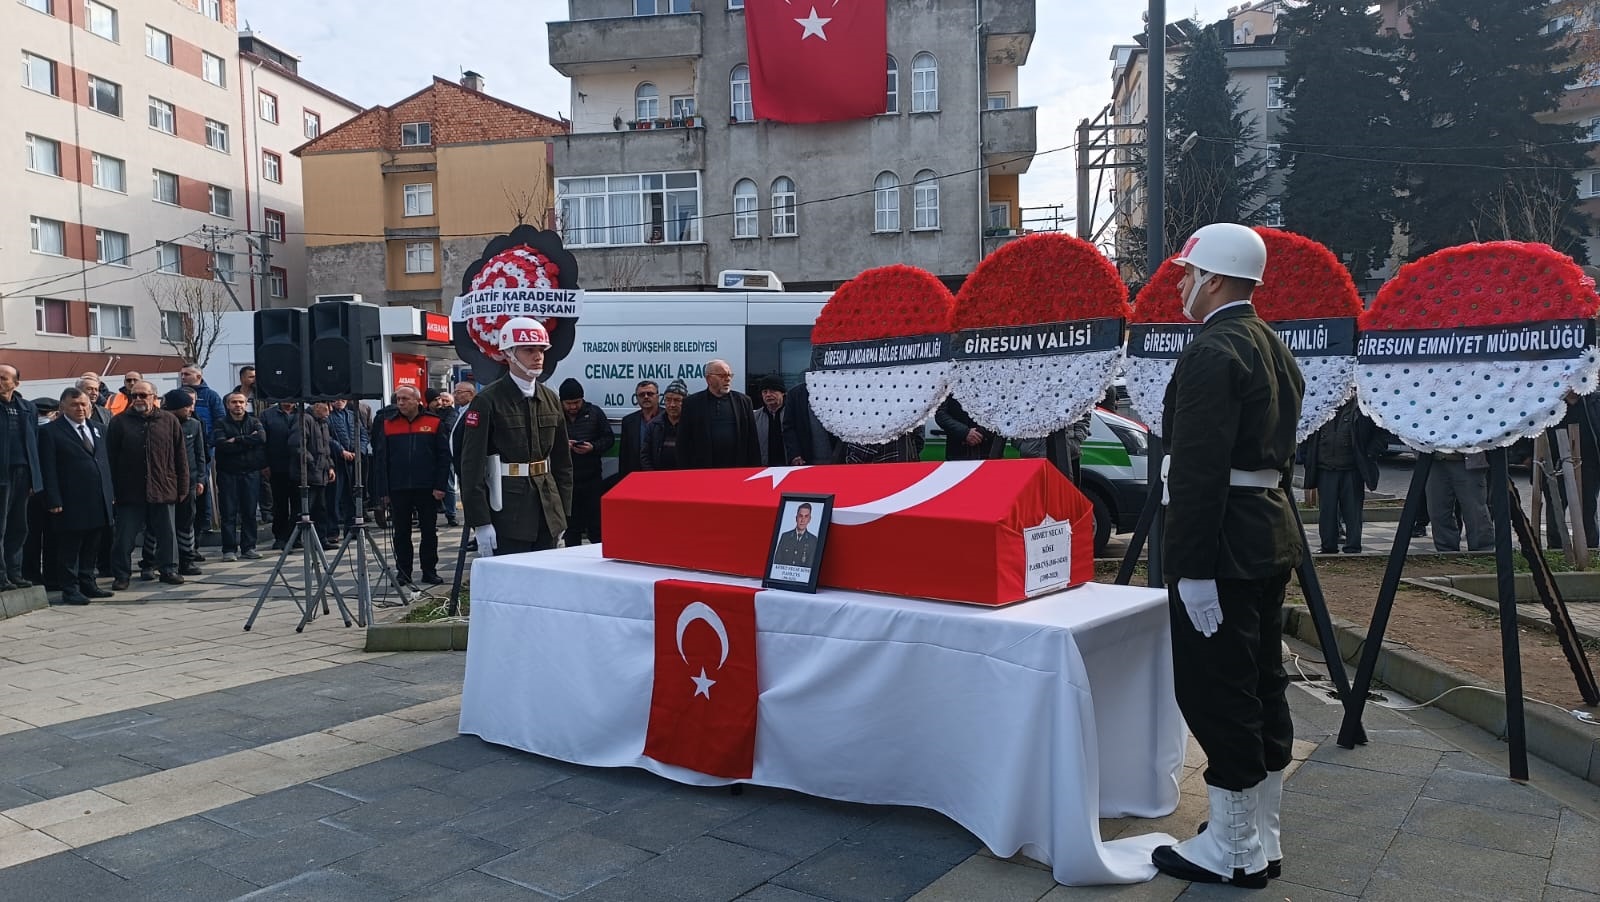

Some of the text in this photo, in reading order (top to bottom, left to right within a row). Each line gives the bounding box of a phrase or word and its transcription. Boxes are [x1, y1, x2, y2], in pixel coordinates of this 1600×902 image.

[475, 290, 499, 303] LATİF
[502, 290, 577, 302] KARADENİZ
[476, 302, 520, 314] BELEDİYE
[523, 303, 576, 315] BAŞKANI
[427, 322, 448, 334] AKBANK
[964, 324, 1092, 354] GİRESUN VALİSİ
[1143, 327, 1185, 353] GİRESUN
[1357, 324, 1586, 357] GİRESUN EMNİYET MÜDÜRLÜĞÜ
[582, 340, 718, 354] TRABZON BÜYÜKŞEHİR BELEDİYESİ
[823, 337, 942, 366] GİRESUN JANDARMA BÖLGE KOMUTANLIĞI
[584, 363, 634, 380] CENAZE
[604, 393, 625, 407] ALO
